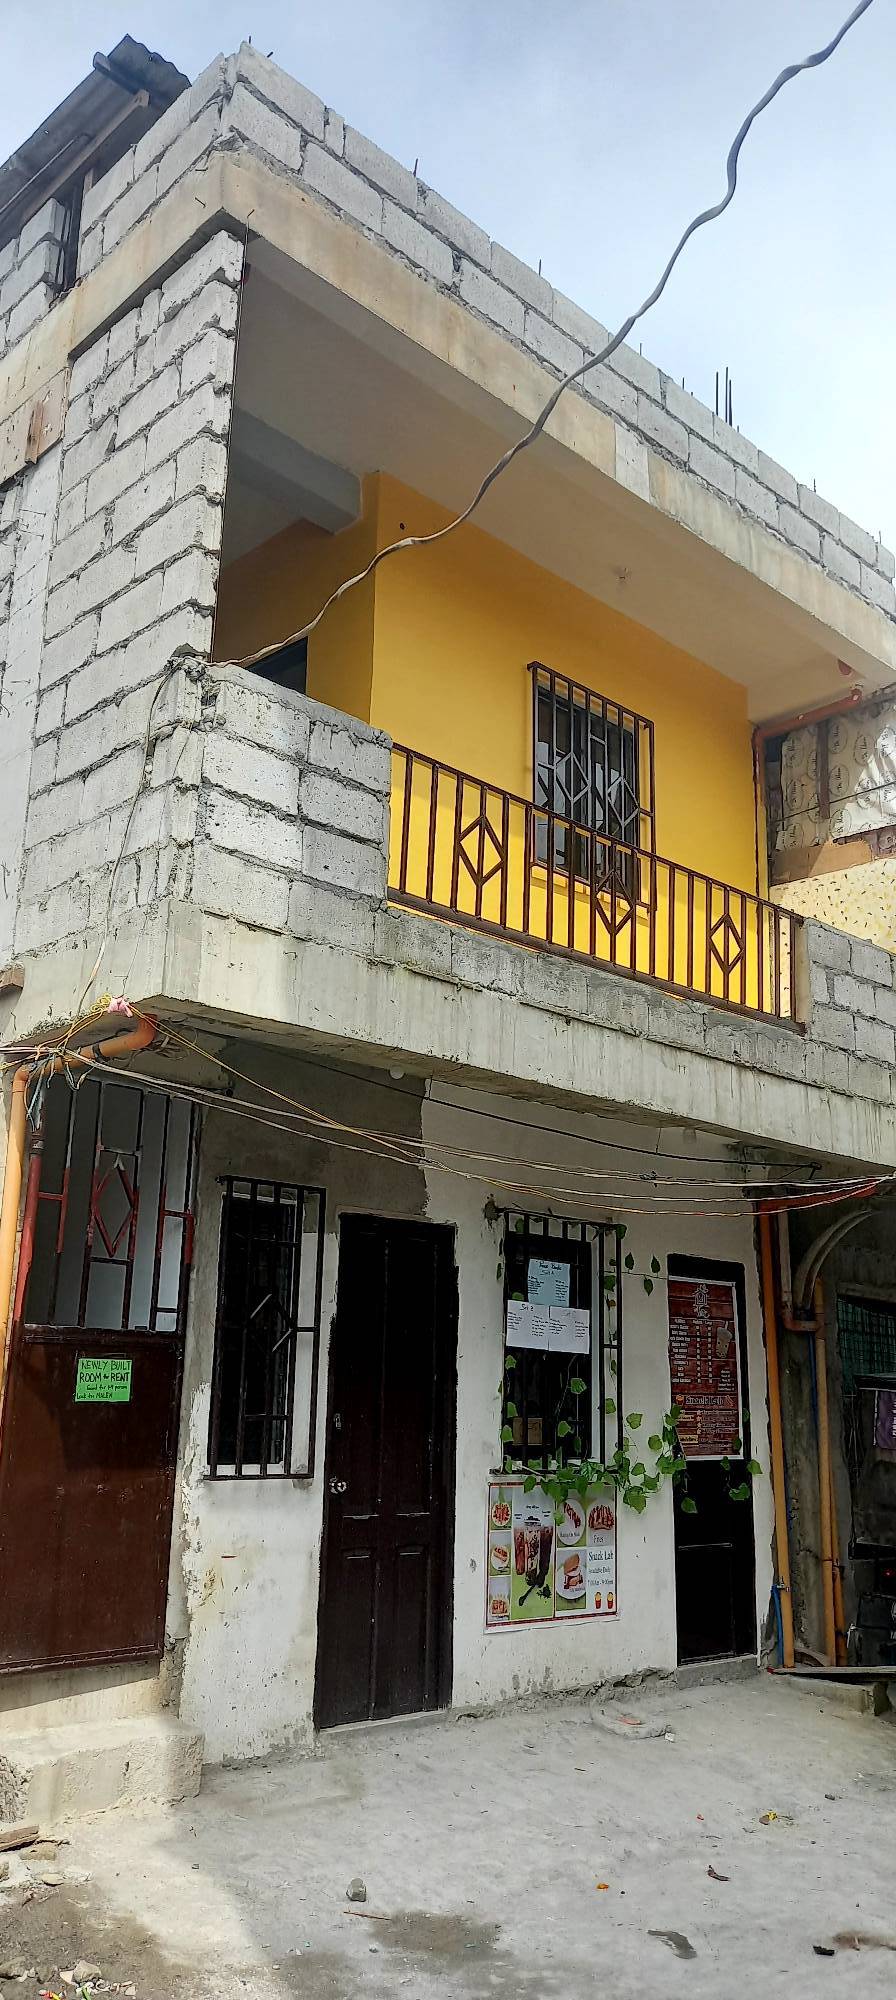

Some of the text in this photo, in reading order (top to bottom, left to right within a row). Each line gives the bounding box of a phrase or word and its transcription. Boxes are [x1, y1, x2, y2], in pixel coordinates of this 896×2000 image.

[81, 1360, 132, 1371] NEWLY BUILT
[80, 1372, 101, 1383] ROOM
[111, 1372, 130, 1382] RENT
